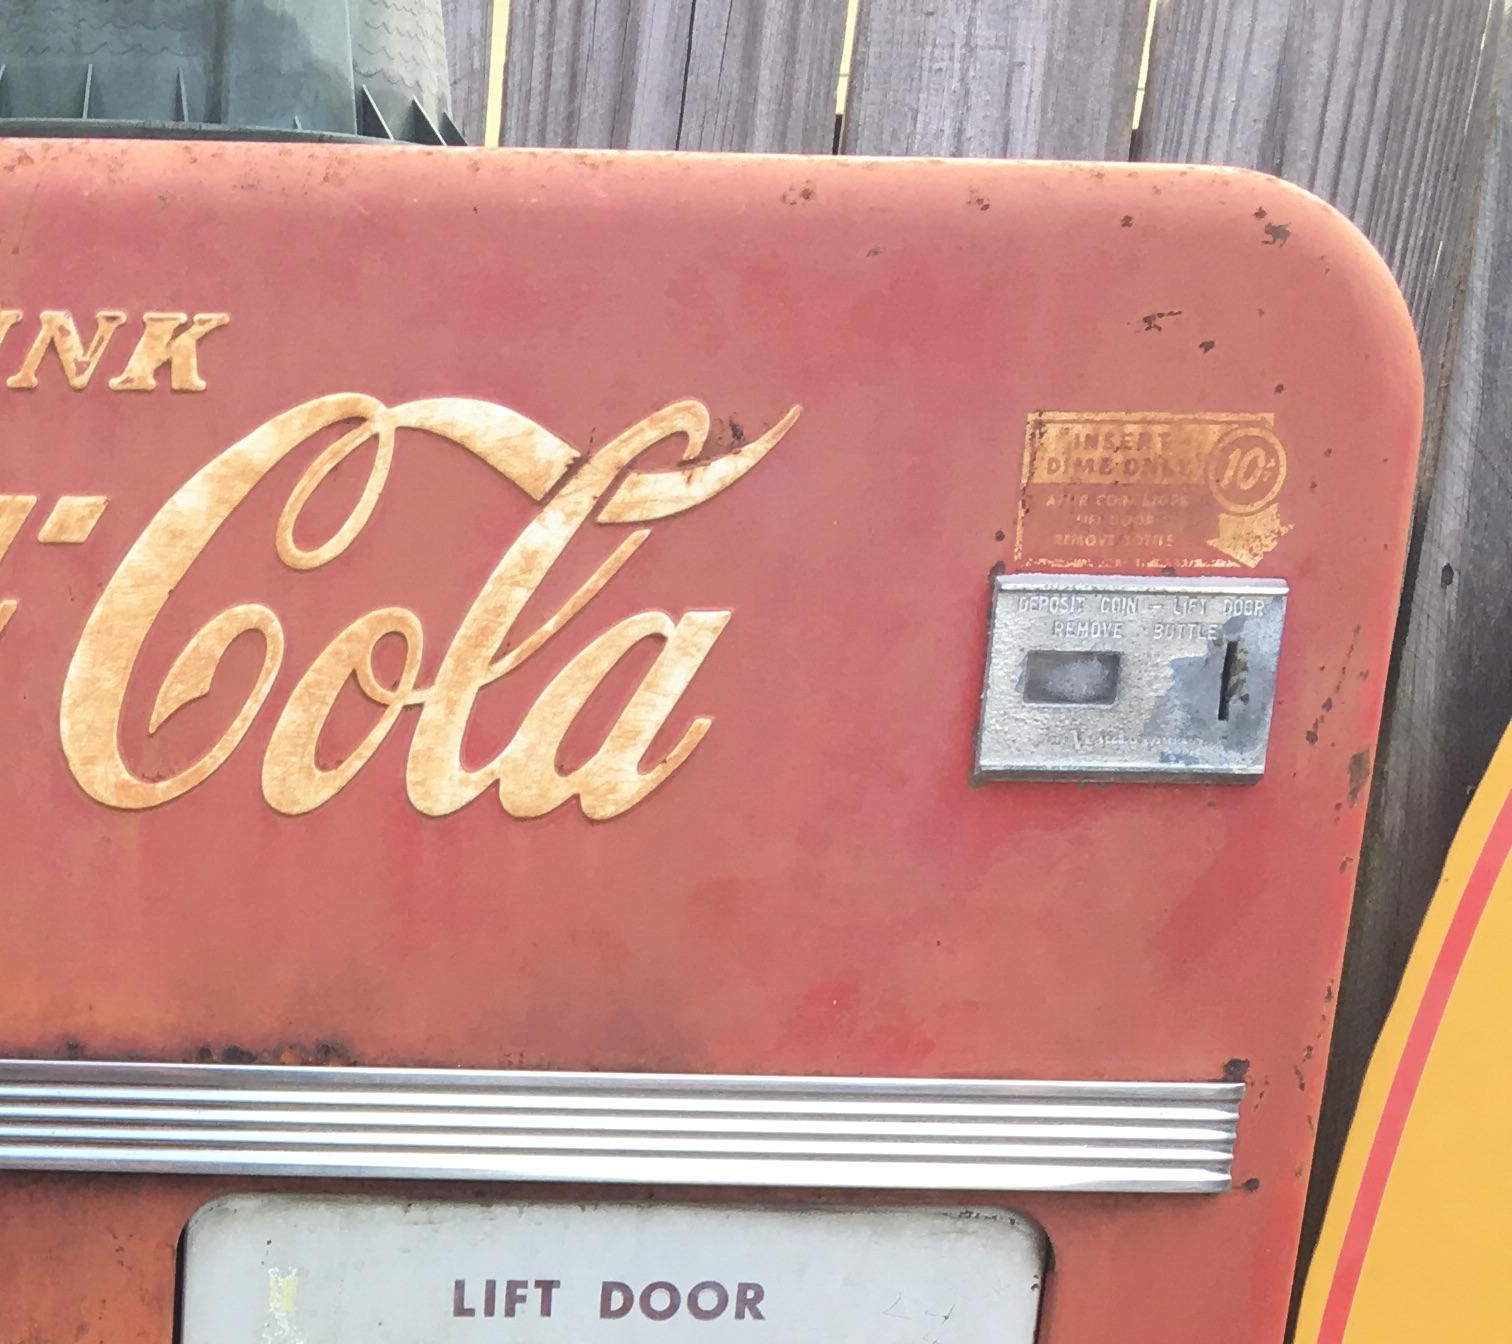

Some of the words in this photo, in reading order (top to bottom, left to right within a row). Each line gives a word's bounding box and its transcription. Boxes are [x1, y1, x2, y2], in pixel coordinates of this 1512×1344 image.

[1072, 431, 1172, 451] INSERT
[1017, 596, 1086, 614] DEPOSIT
[1100, 597, 1139, 615] COIN
[1172, 598, 1208, 616] LIFT
[1222, 599, 1266, 617] DOOR
[1052, 621, 1123, 640] REMOVE
[1152, 623, 1219, 641] BOTTLE
[452, 1278, 562, 1320] LIFT
[598, 1280, 767, 1322] DOOR
